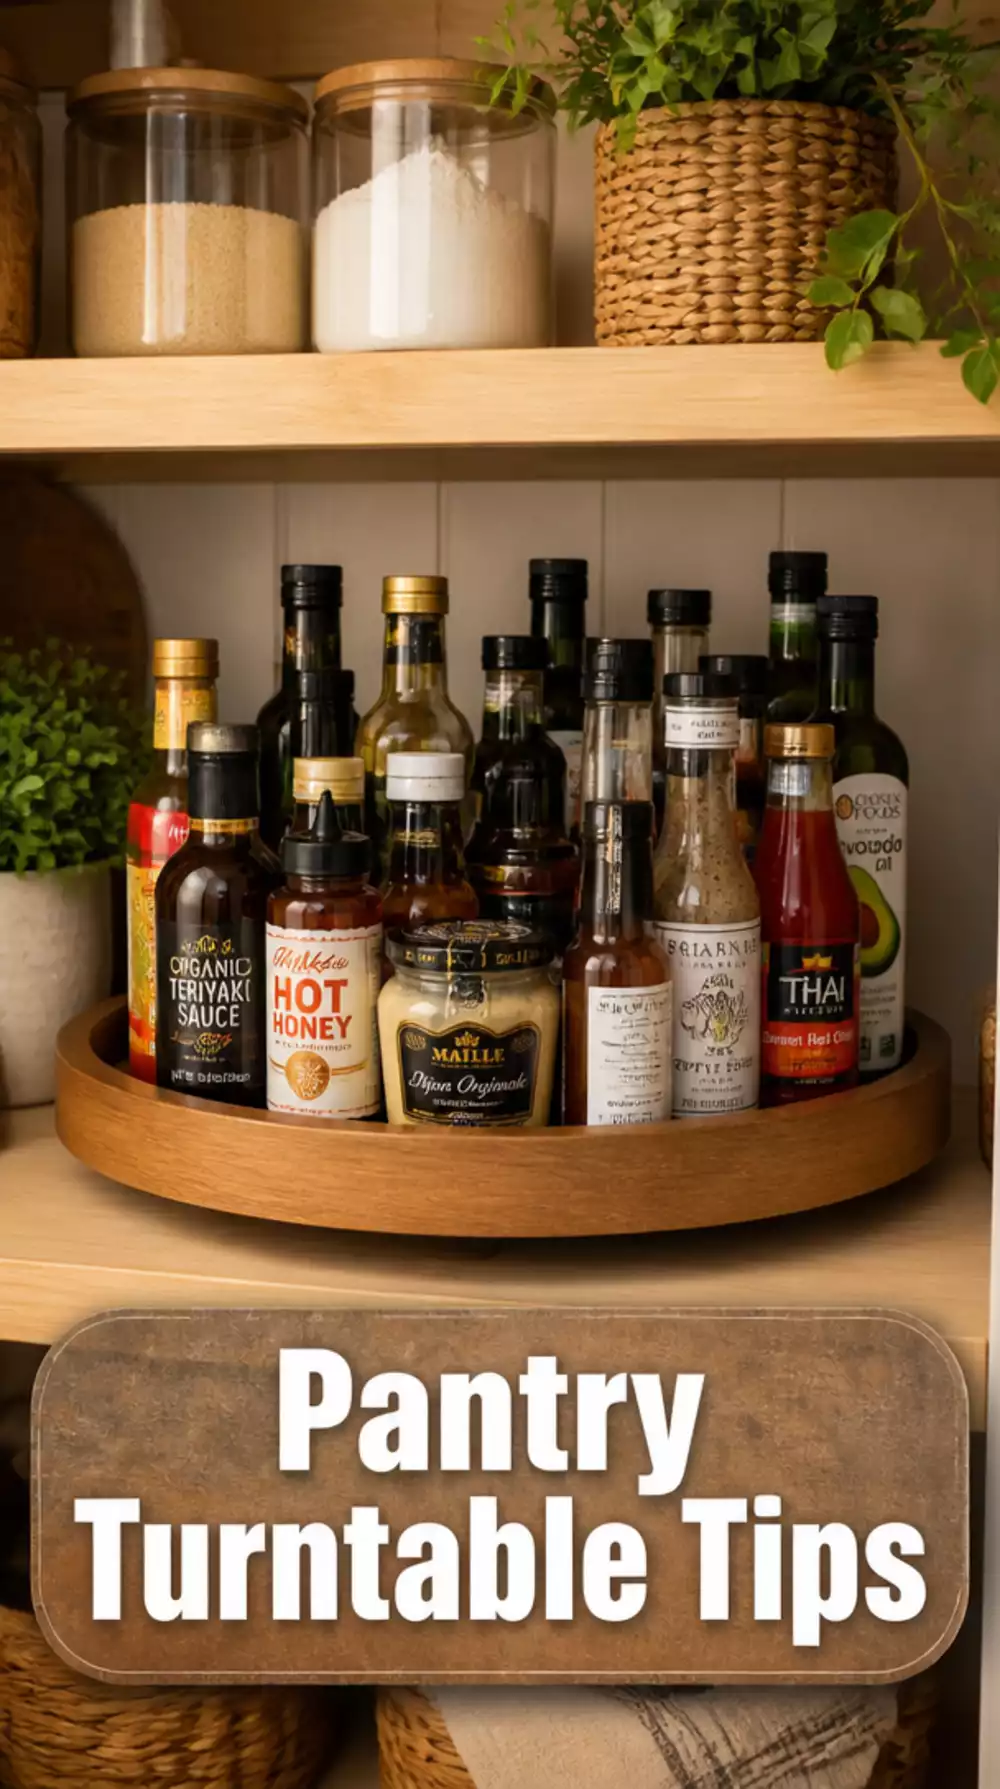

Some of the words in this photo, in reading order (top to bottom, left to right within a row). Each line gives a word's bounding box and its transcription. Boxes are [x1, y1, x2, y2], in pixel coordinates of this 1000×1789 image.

[274, 975, 348, 1014] HOT
[779, 976, 845, 1005] THAI
[178, 1002, 240, 1028] SAUCE
[273, 1011, 352, 1040] HONEY
[432, 1047, 505, 1063] MAILLE
